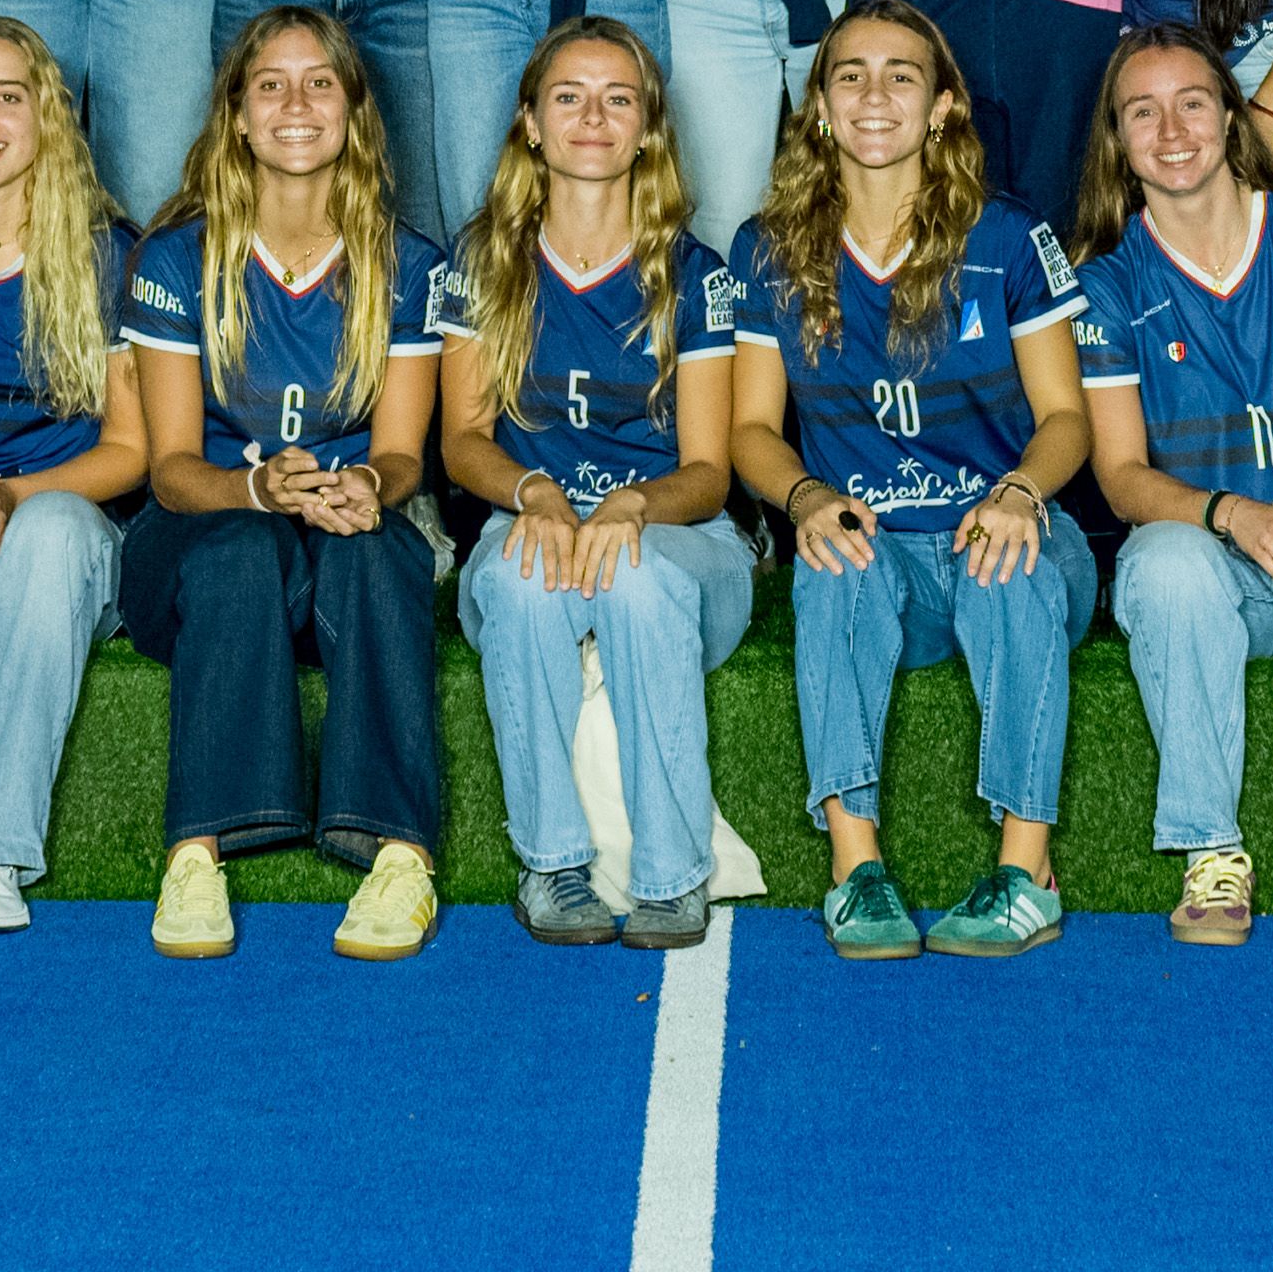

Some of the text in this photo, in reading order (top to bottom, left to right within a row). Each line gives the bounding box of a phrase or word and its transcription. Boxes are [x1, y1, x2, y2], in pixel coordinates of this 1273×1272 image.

[962, 264, 1005, 275] RSCHE
[1043, 244, 1062, 263] EUR
[1048, 256, 1068, 277] HOC
[280, 382, 305, 443] 6
[568, 369, 591, 429] 5
[873, 378, 921, 438] 20
